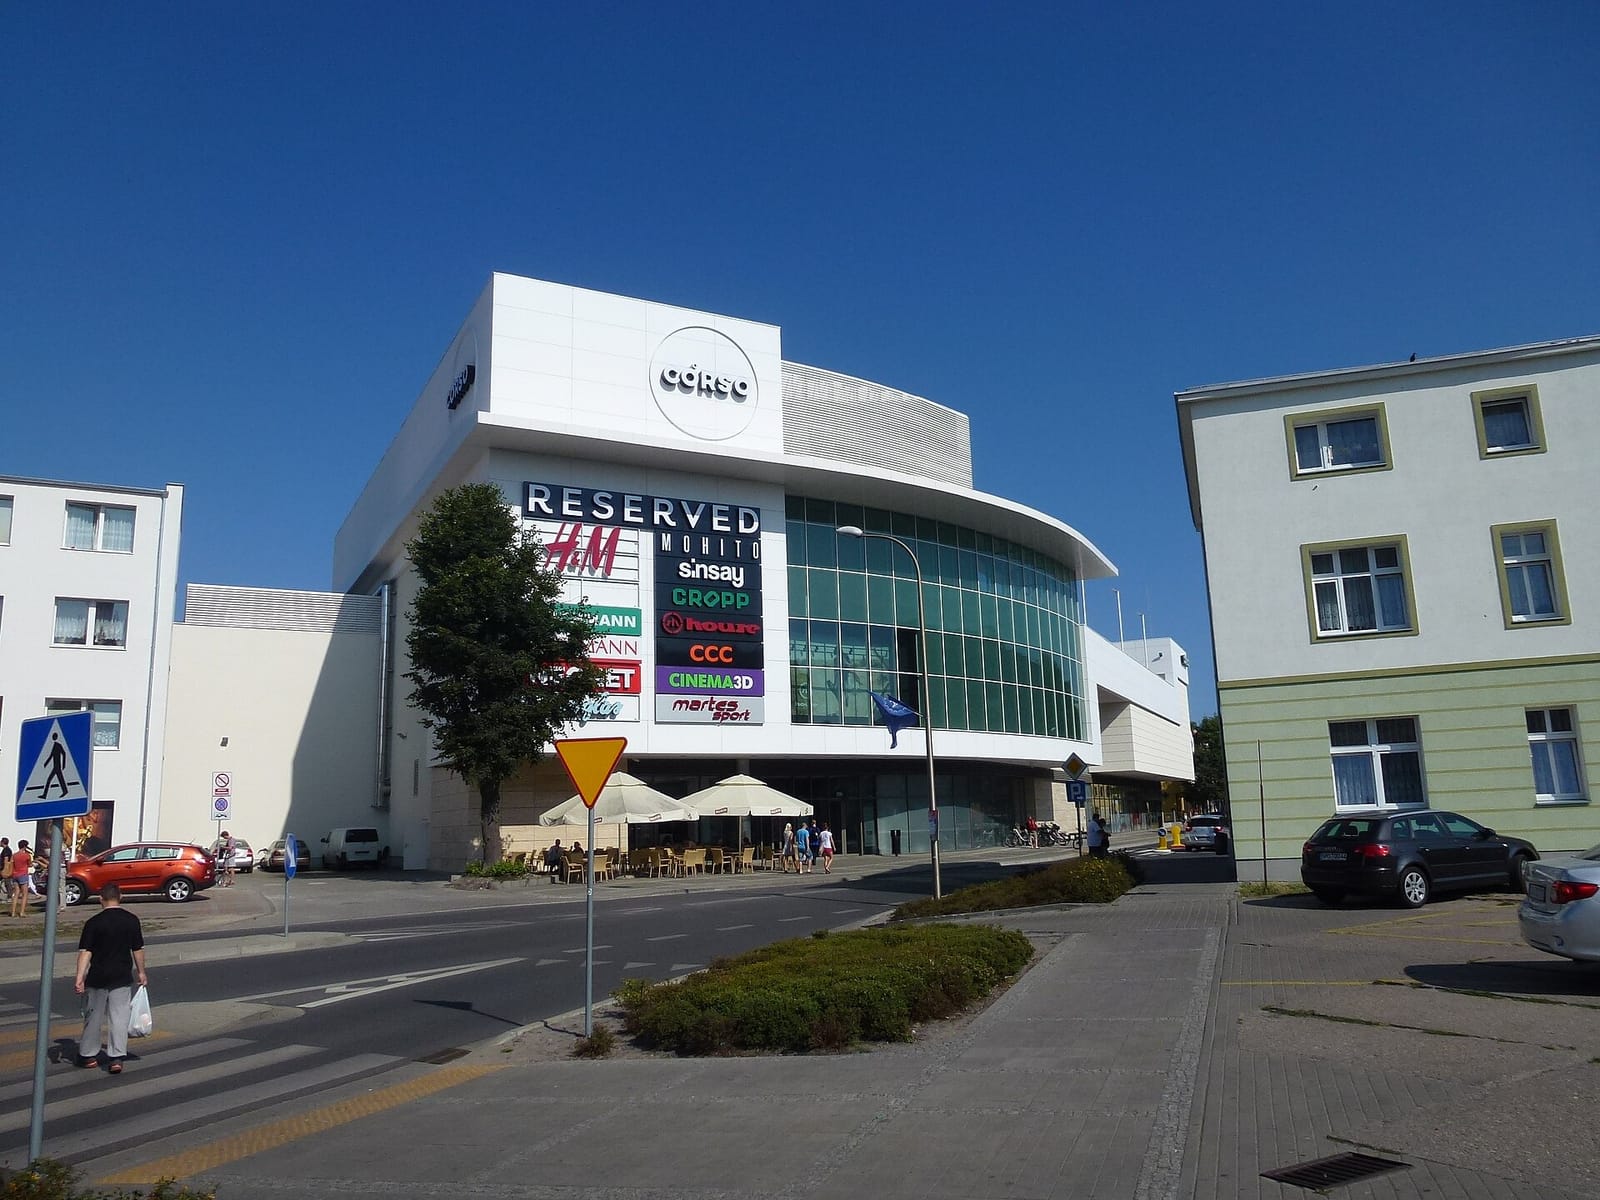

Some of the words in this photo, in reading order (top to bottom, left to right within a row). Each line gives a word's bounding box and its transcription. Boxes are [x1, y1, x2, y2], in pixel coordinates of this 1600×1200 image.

[528, 484, 759, 534] RESERVED
[544, 522, 621, 577] H&M
[661, 532, 759, 559] MOHITO
[678, 558, 744, 588] sinsay
[672, 588, 750, 609] CROPP
[689, 644, 733, 663] CCC
[669, 673, 754, 689] CINEMA3D
[672, 696, 739, 712] martes
[712, 710, 751, 724] sport
